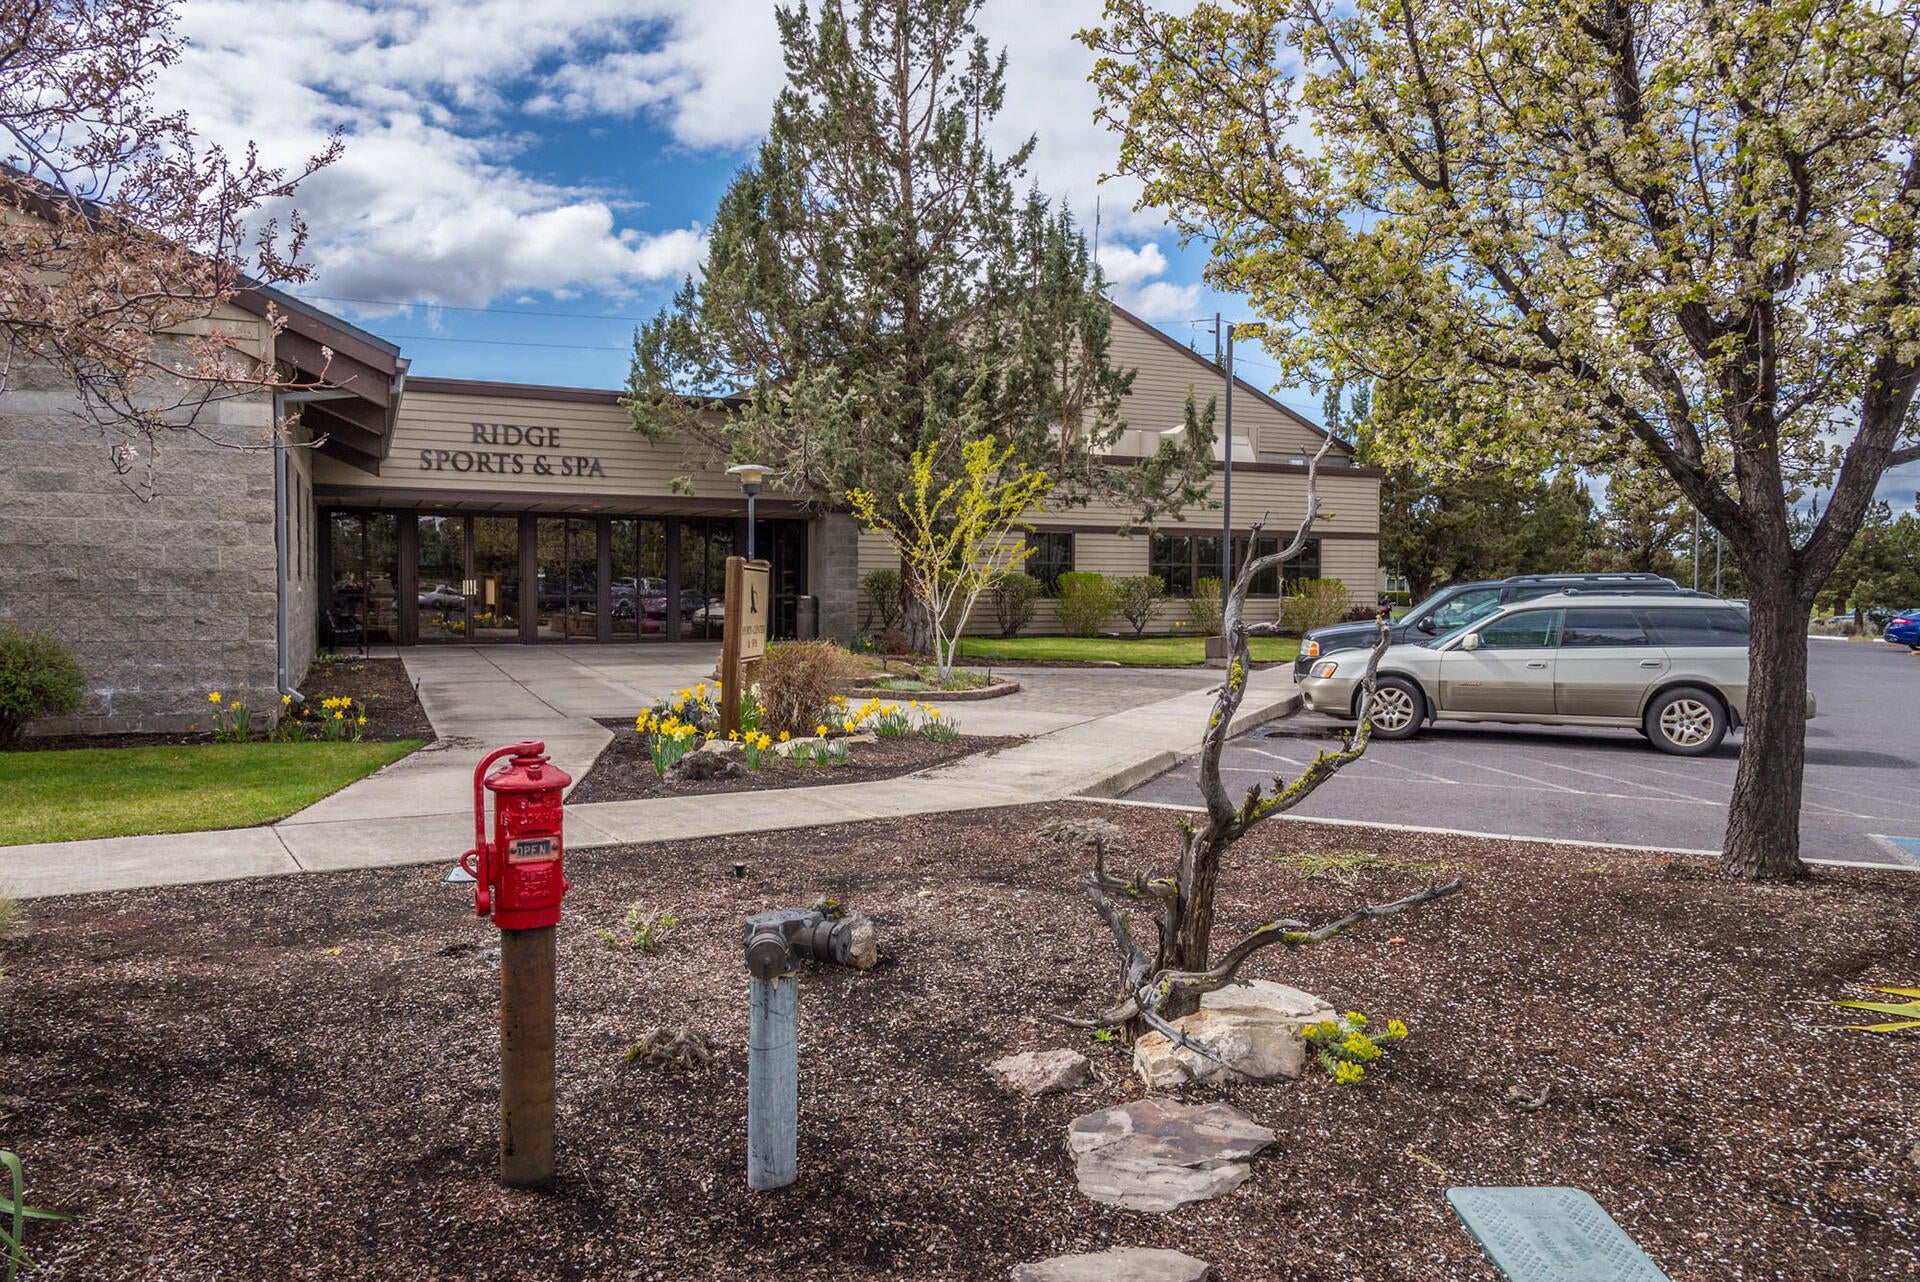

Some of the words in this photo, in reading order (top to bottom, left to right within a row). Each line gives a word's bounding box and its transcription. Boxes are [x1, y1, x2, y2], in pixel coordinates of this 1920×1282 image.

[472, 423, 560, 447] RIDGE
[420, 449, 524, 474] SPORTS
[533, 455, 554, 476] &
[561, 456, 606, 477] SPA
[517, 844, 547, 857] OPEN
